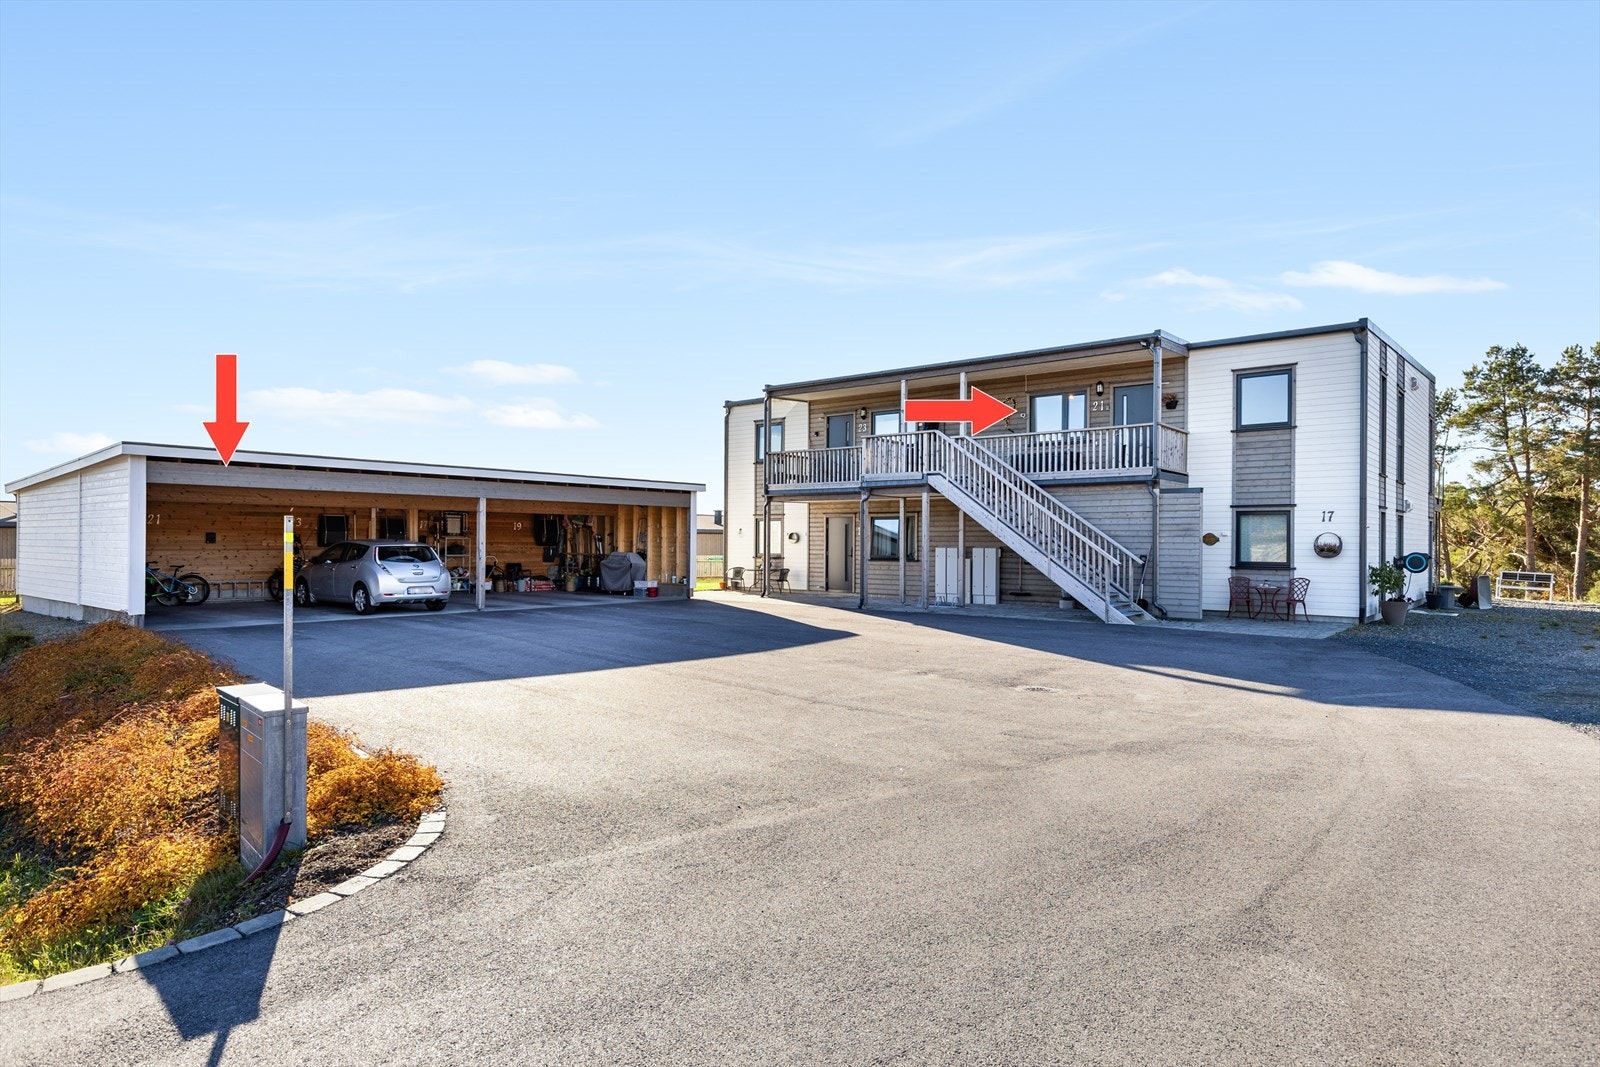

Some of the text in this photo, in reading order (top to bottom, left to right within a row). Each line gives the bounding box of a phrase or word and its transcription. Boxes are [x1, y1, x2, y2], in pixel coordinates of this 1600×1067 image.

[1092, 401, 1104, 411] 21
[858, 423, 867, 432] 23
[147, 514, 160, 525] 21
[1321, 511, 1334, 522] 17
[513, 522, 522, 531] 19
